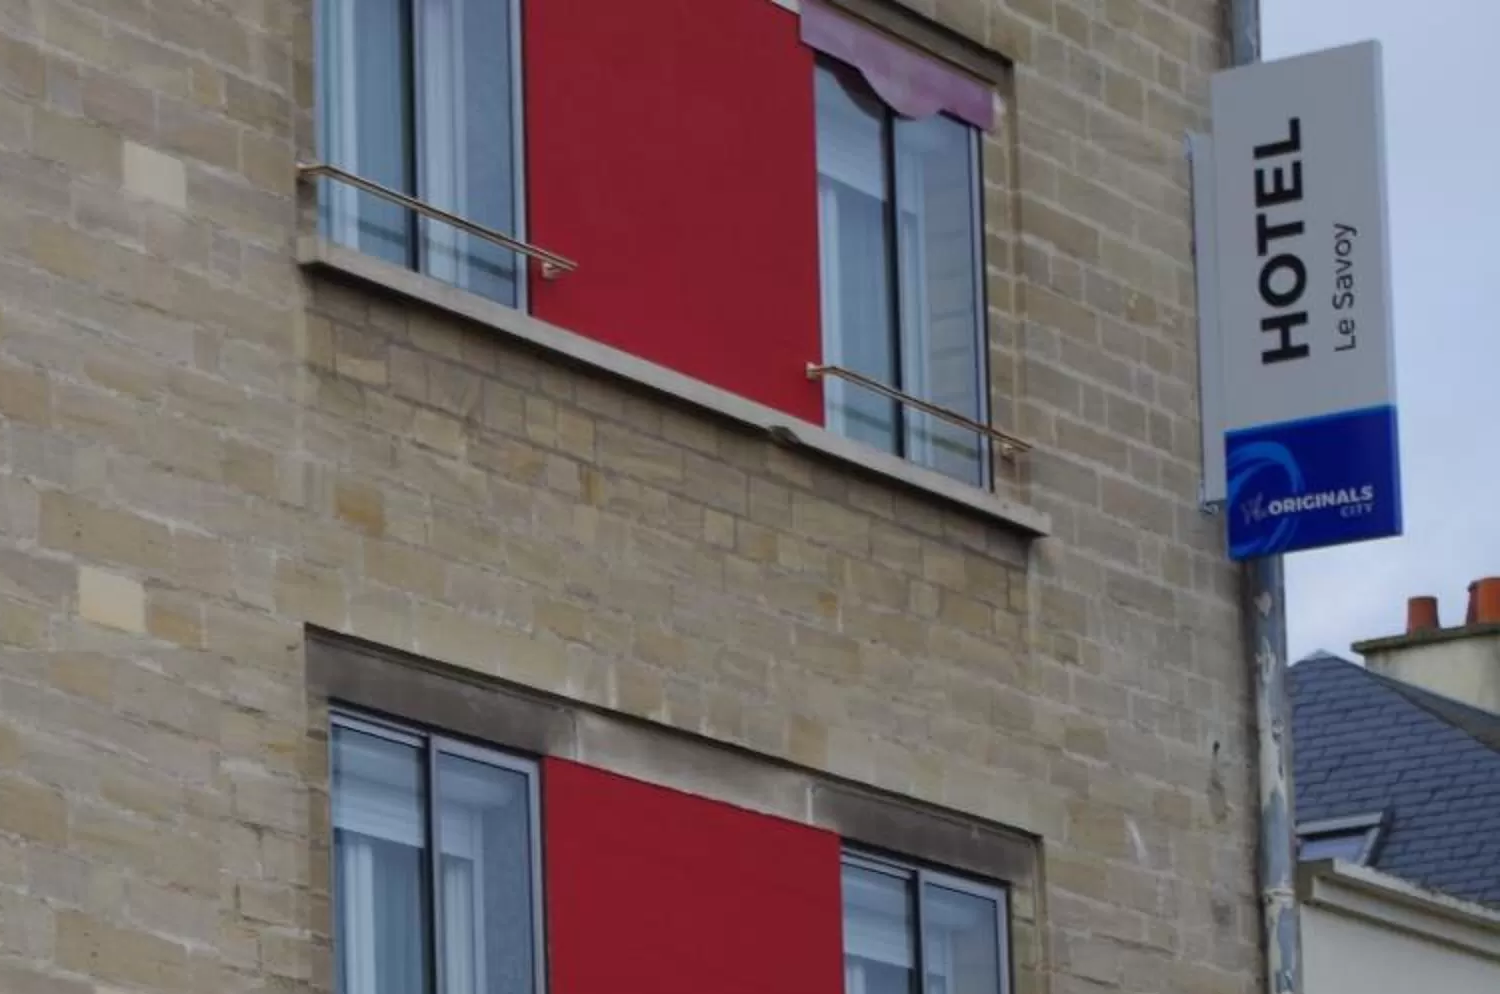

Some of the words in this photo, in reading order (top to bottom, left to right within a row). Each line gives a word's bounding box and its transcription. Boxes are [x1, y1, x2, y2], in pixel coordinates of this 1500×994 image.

[1252, 116, 1310, 364] HOTEL
[1332, 222, 1357, 309] Savoy
[1334, 317, 1357, 352] Le
[1267, 484, 1373, 516] ORIGINALS
[1339, 503, 1373, 519] CITY
